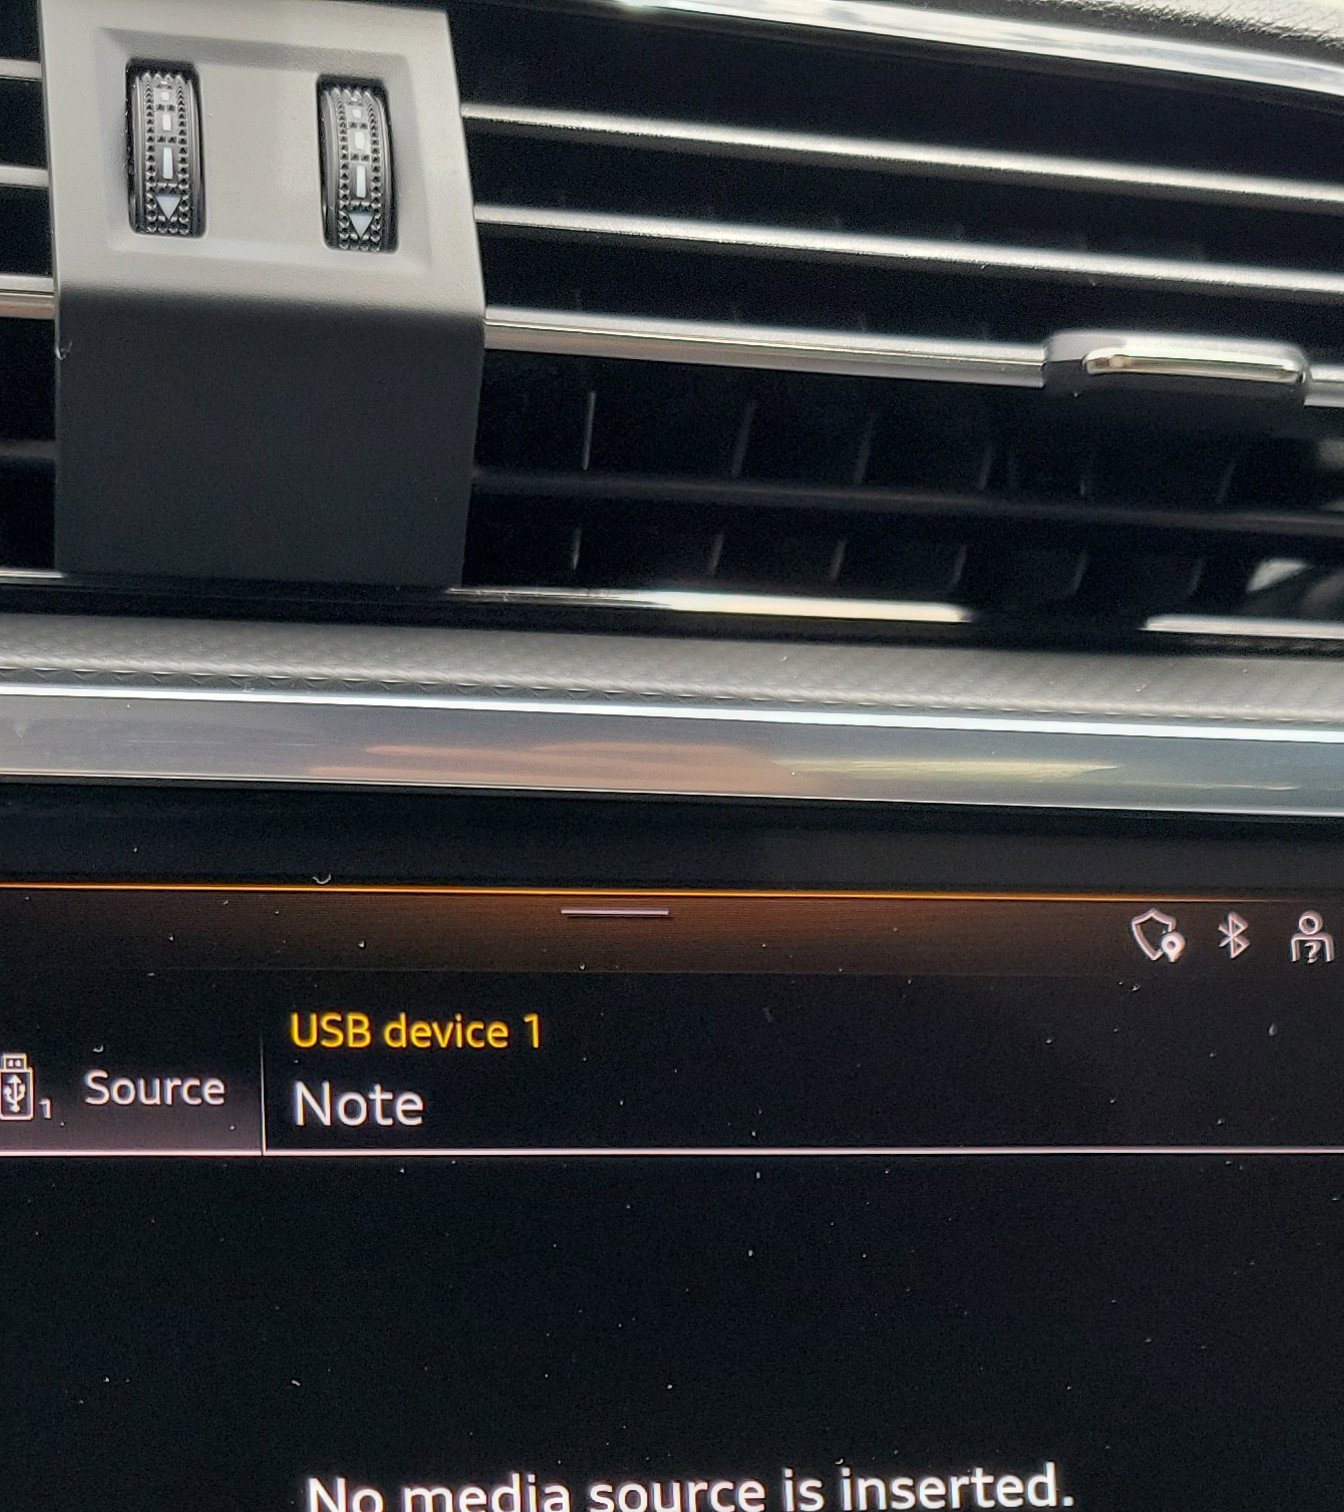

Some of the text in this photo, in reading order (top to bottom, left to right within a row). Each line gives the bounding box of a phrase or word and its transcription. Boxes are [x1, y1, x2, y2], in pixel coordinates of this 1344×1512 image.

[291, 1012, 540, 1049] USB device 1
[84, 1070, 225, 1105] Source
[294, 1081, 424, 1126] Note
[39, 1098, 51, 1119] 1
[783, 1468, 825, 1512] is
[841, 1463, 1074, 1511] inserted.
